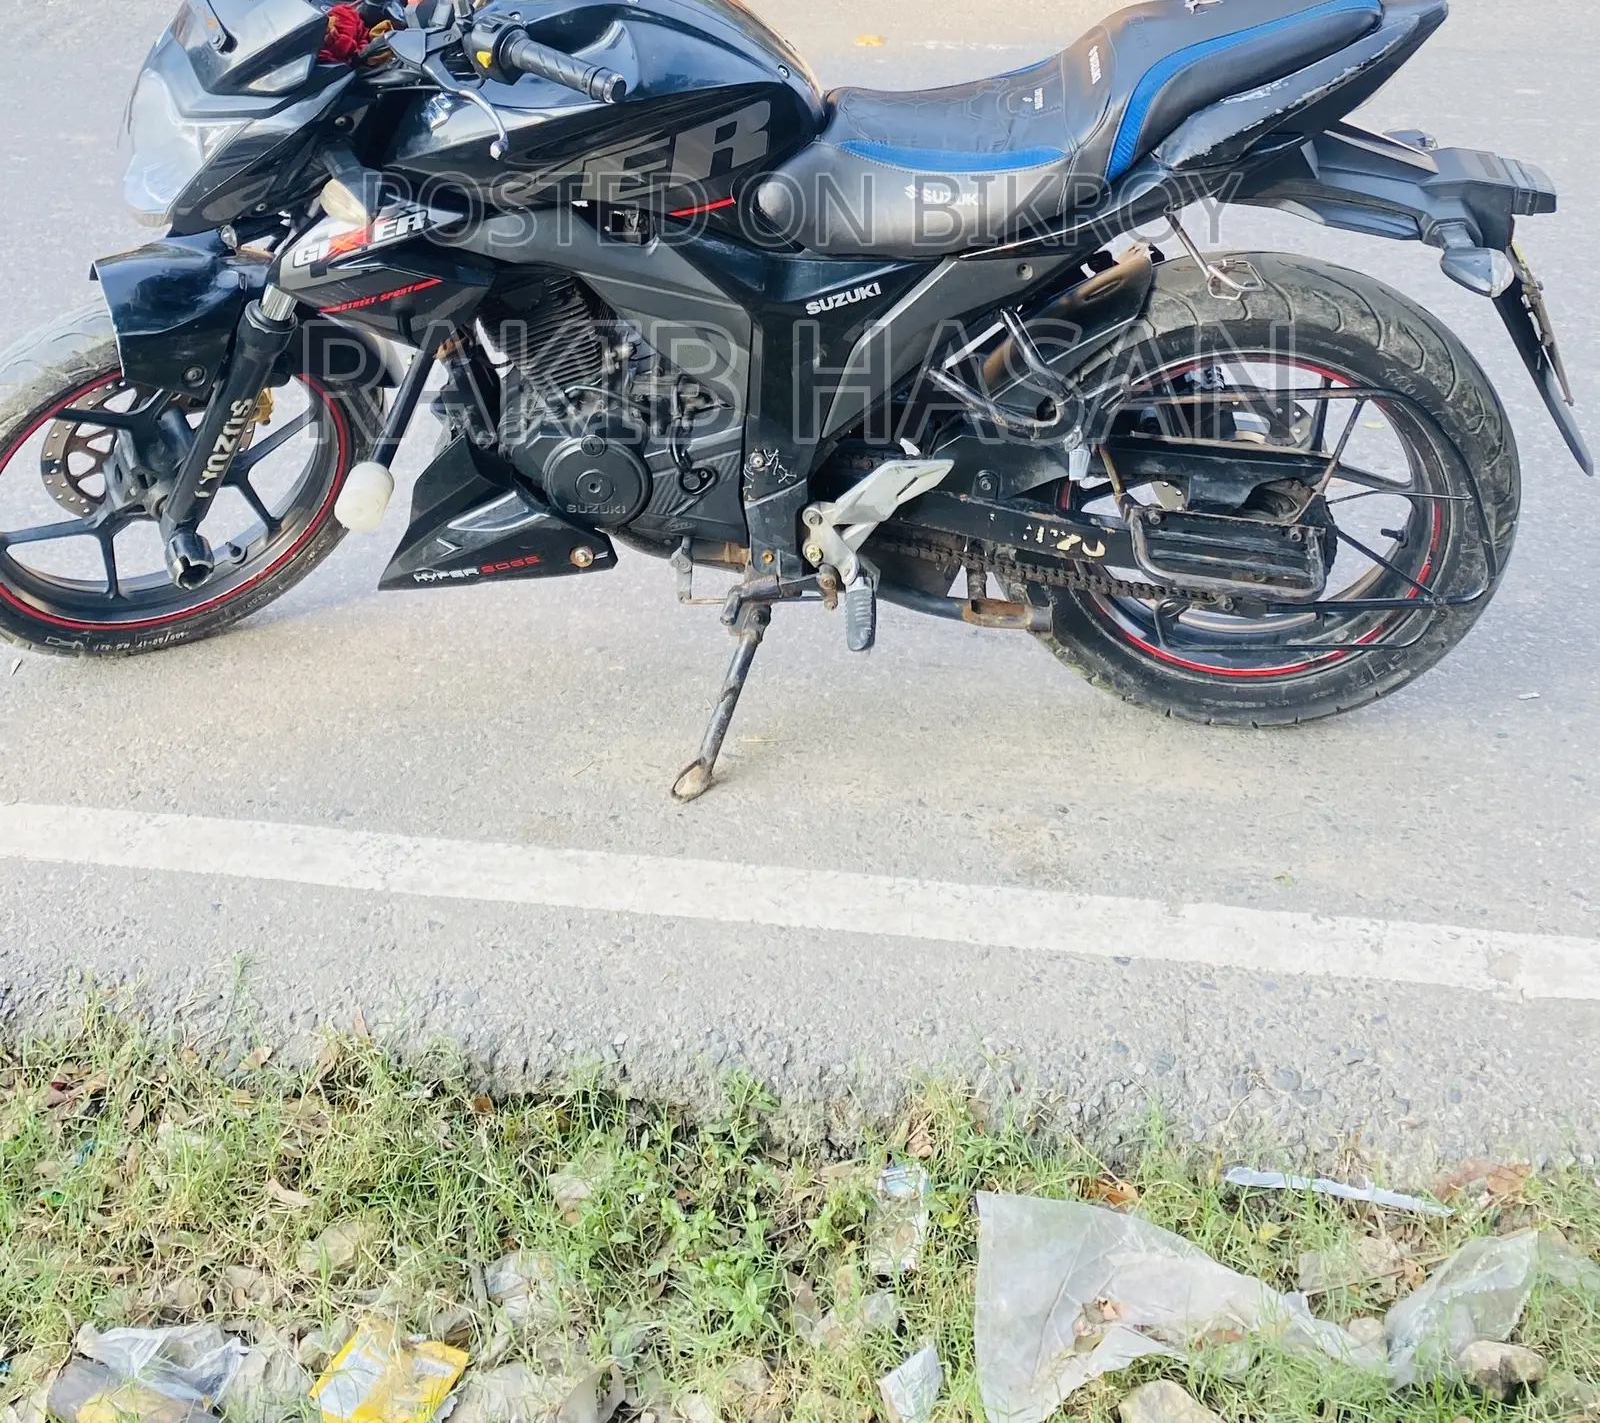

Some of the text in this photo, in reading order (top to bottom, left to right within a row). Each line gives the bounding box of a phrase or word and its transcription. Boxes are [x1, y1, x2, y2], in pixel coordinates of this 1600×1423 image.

[380, 285, 414, 301] SPORT
[805, 282, 882, 315] SUZUKI
[566, 504, 627, 515] SUZUKI
[412, 566, 480, 583] HYPER
